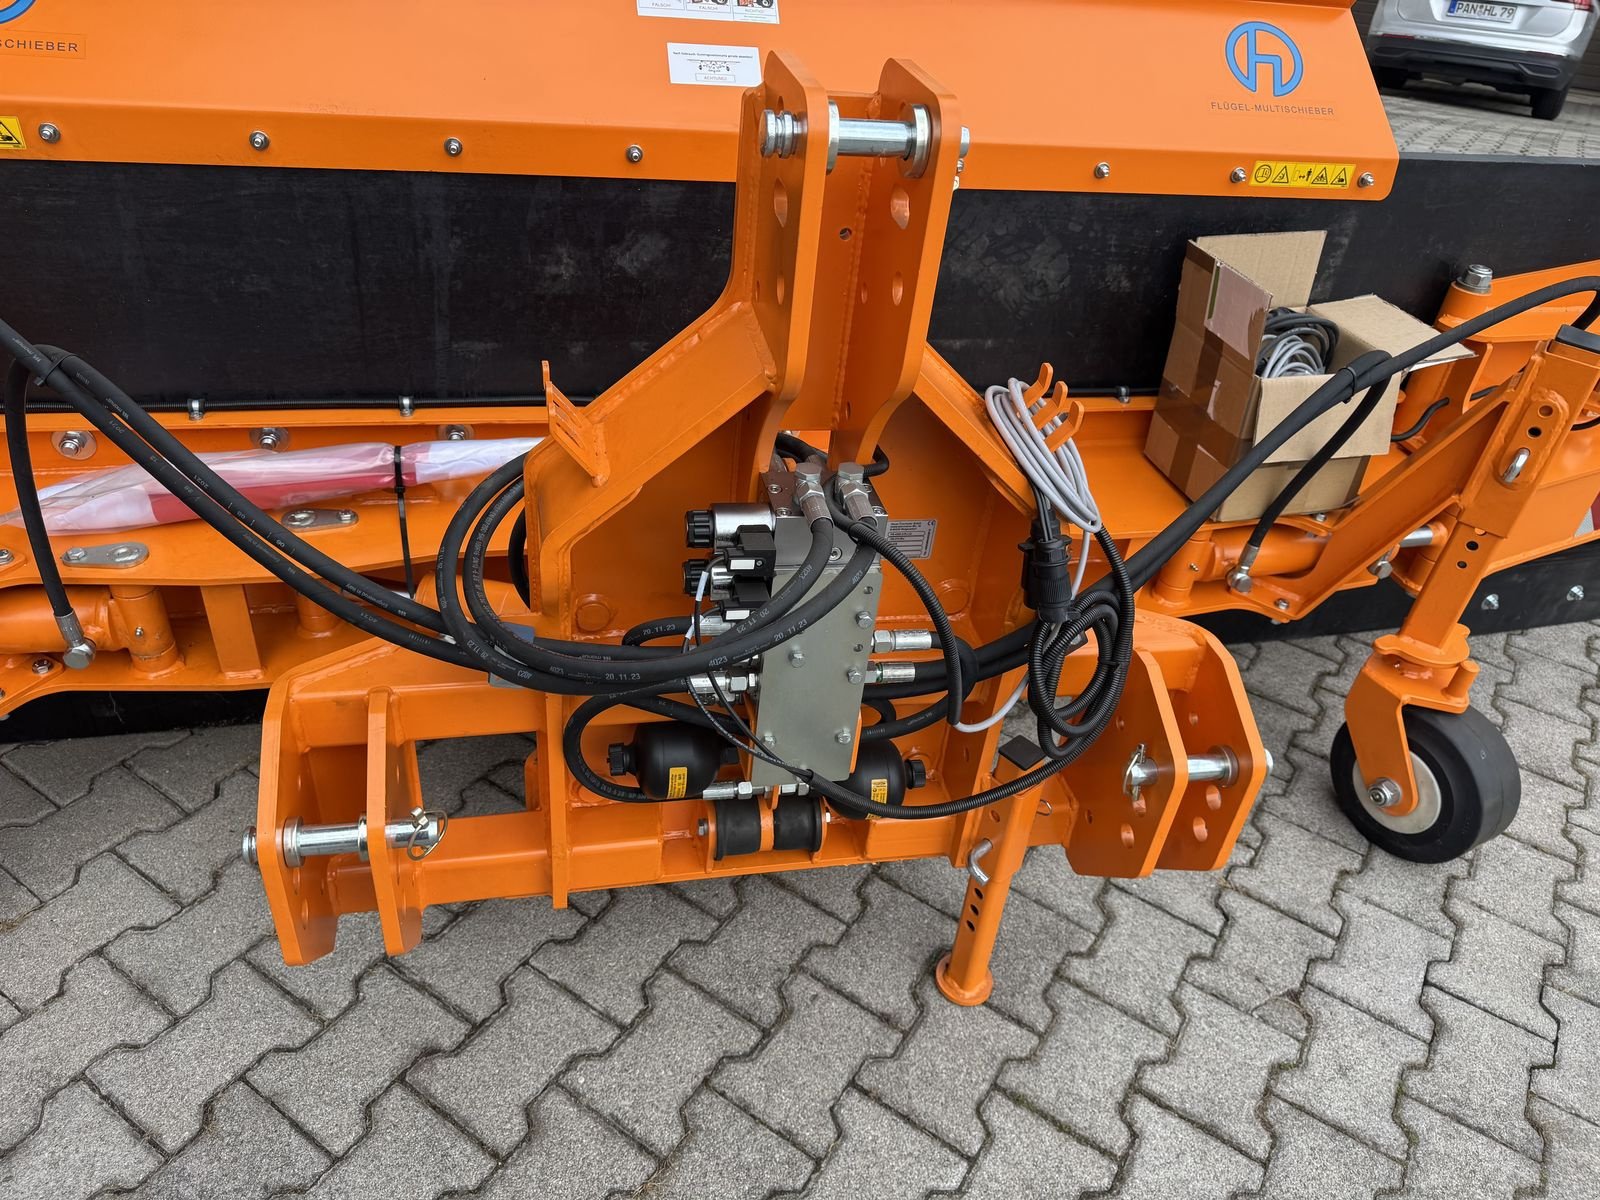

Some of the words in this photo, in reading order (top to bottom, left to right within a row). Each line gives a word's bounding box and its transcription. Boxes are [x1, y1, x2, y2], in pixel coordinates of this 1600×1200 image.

[1456, 2, 1477, 14] PAN
[1500, 7, 1515, 18] 79
[0, 39, 78, 52] CHIEBER
[1210, 101, 1334, 116] FLÜGEL-MULTISCHIEBER
[643, 624, 676, 636] 20.11.23
[774, 619, 808, 642] 20.11.23
[605, 673, 641, 681] 20.11.23
